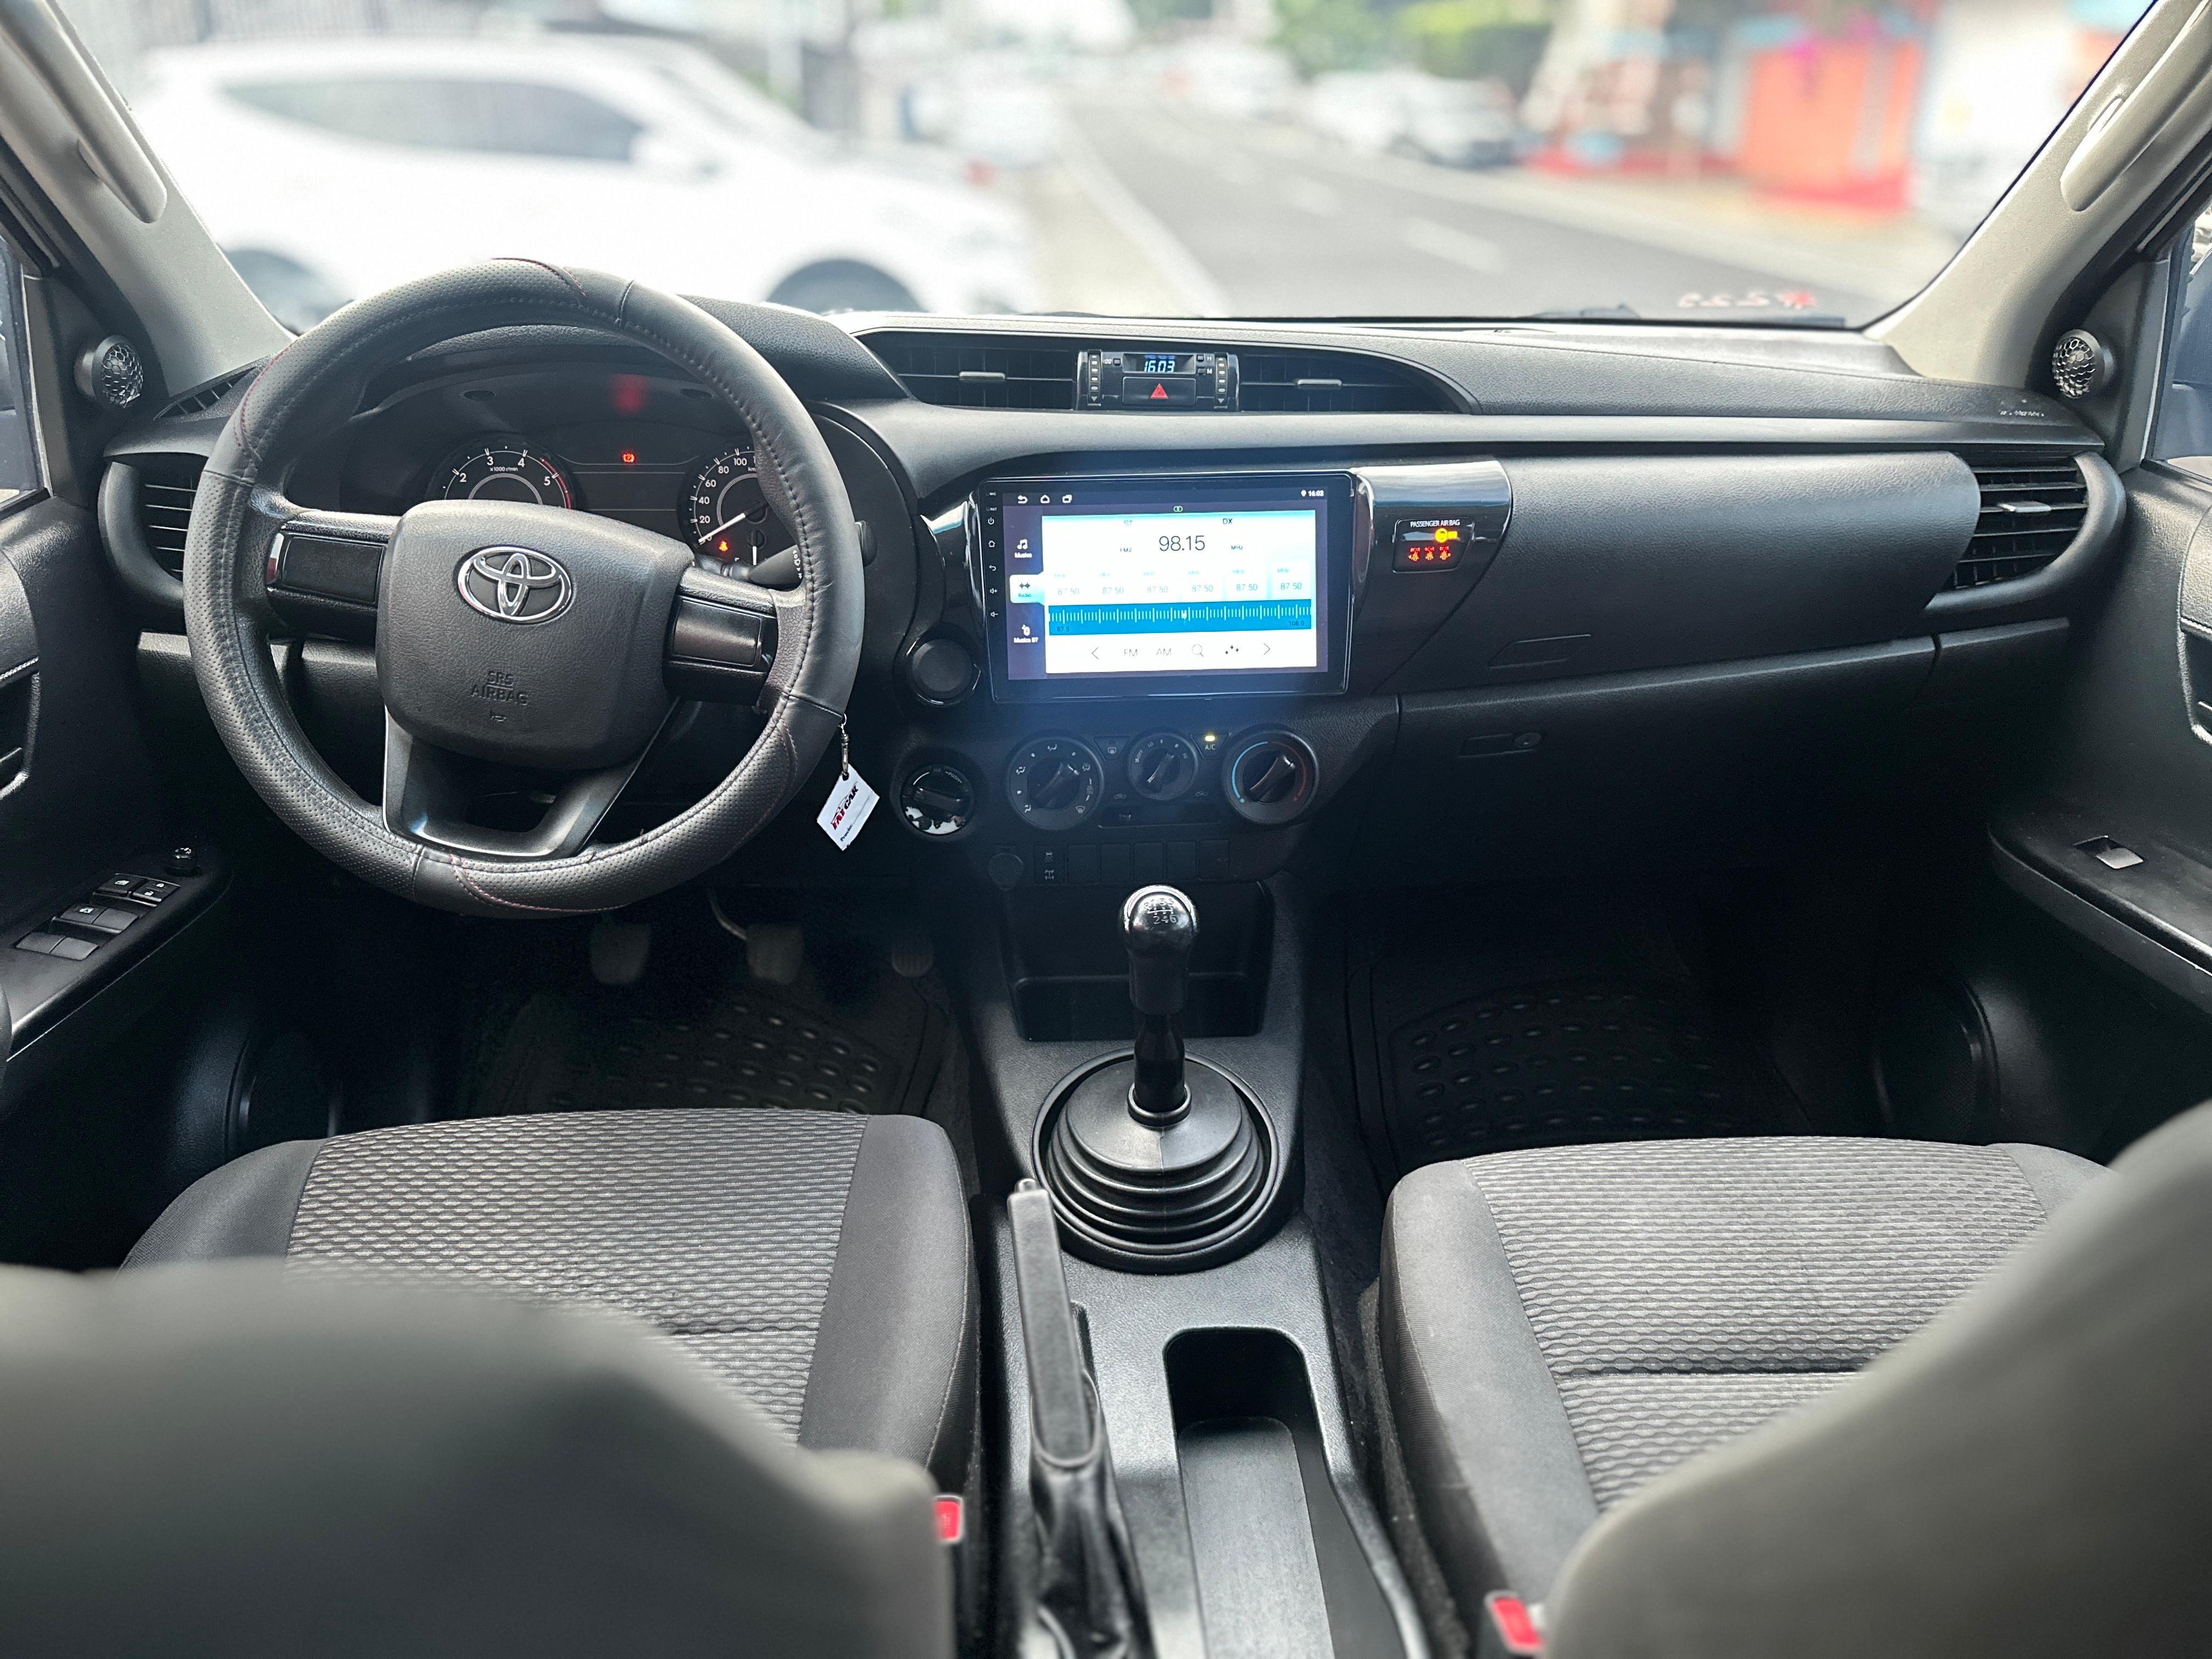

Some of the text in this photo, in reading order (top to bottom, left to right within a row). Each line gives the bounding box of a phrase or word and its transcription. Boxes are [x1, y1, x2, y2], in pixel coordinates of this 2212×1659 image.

[487, 456, 494, 466] 3
[517, 458, 525, 467] 4
[733, 458, 747, 466] 100
[718, 466, 730, 474] 80
[459, 472, 467, 483] 2
[544, 476, 551, 486] 5
[705, 479, 716, 488] 60
[698, 496, 710, 505] 40
[699, 515, 711, 524] 20
[1159, 535, 1206, 551] 98.15
[1280, 582, 1302, 590] 8750
[1124, 648, 1138, 657] FM
[1156, 648, 1172, 656] AM
[487, 670, 514, 686] SRS
[470, 684, 528, 706] AIRBAG
